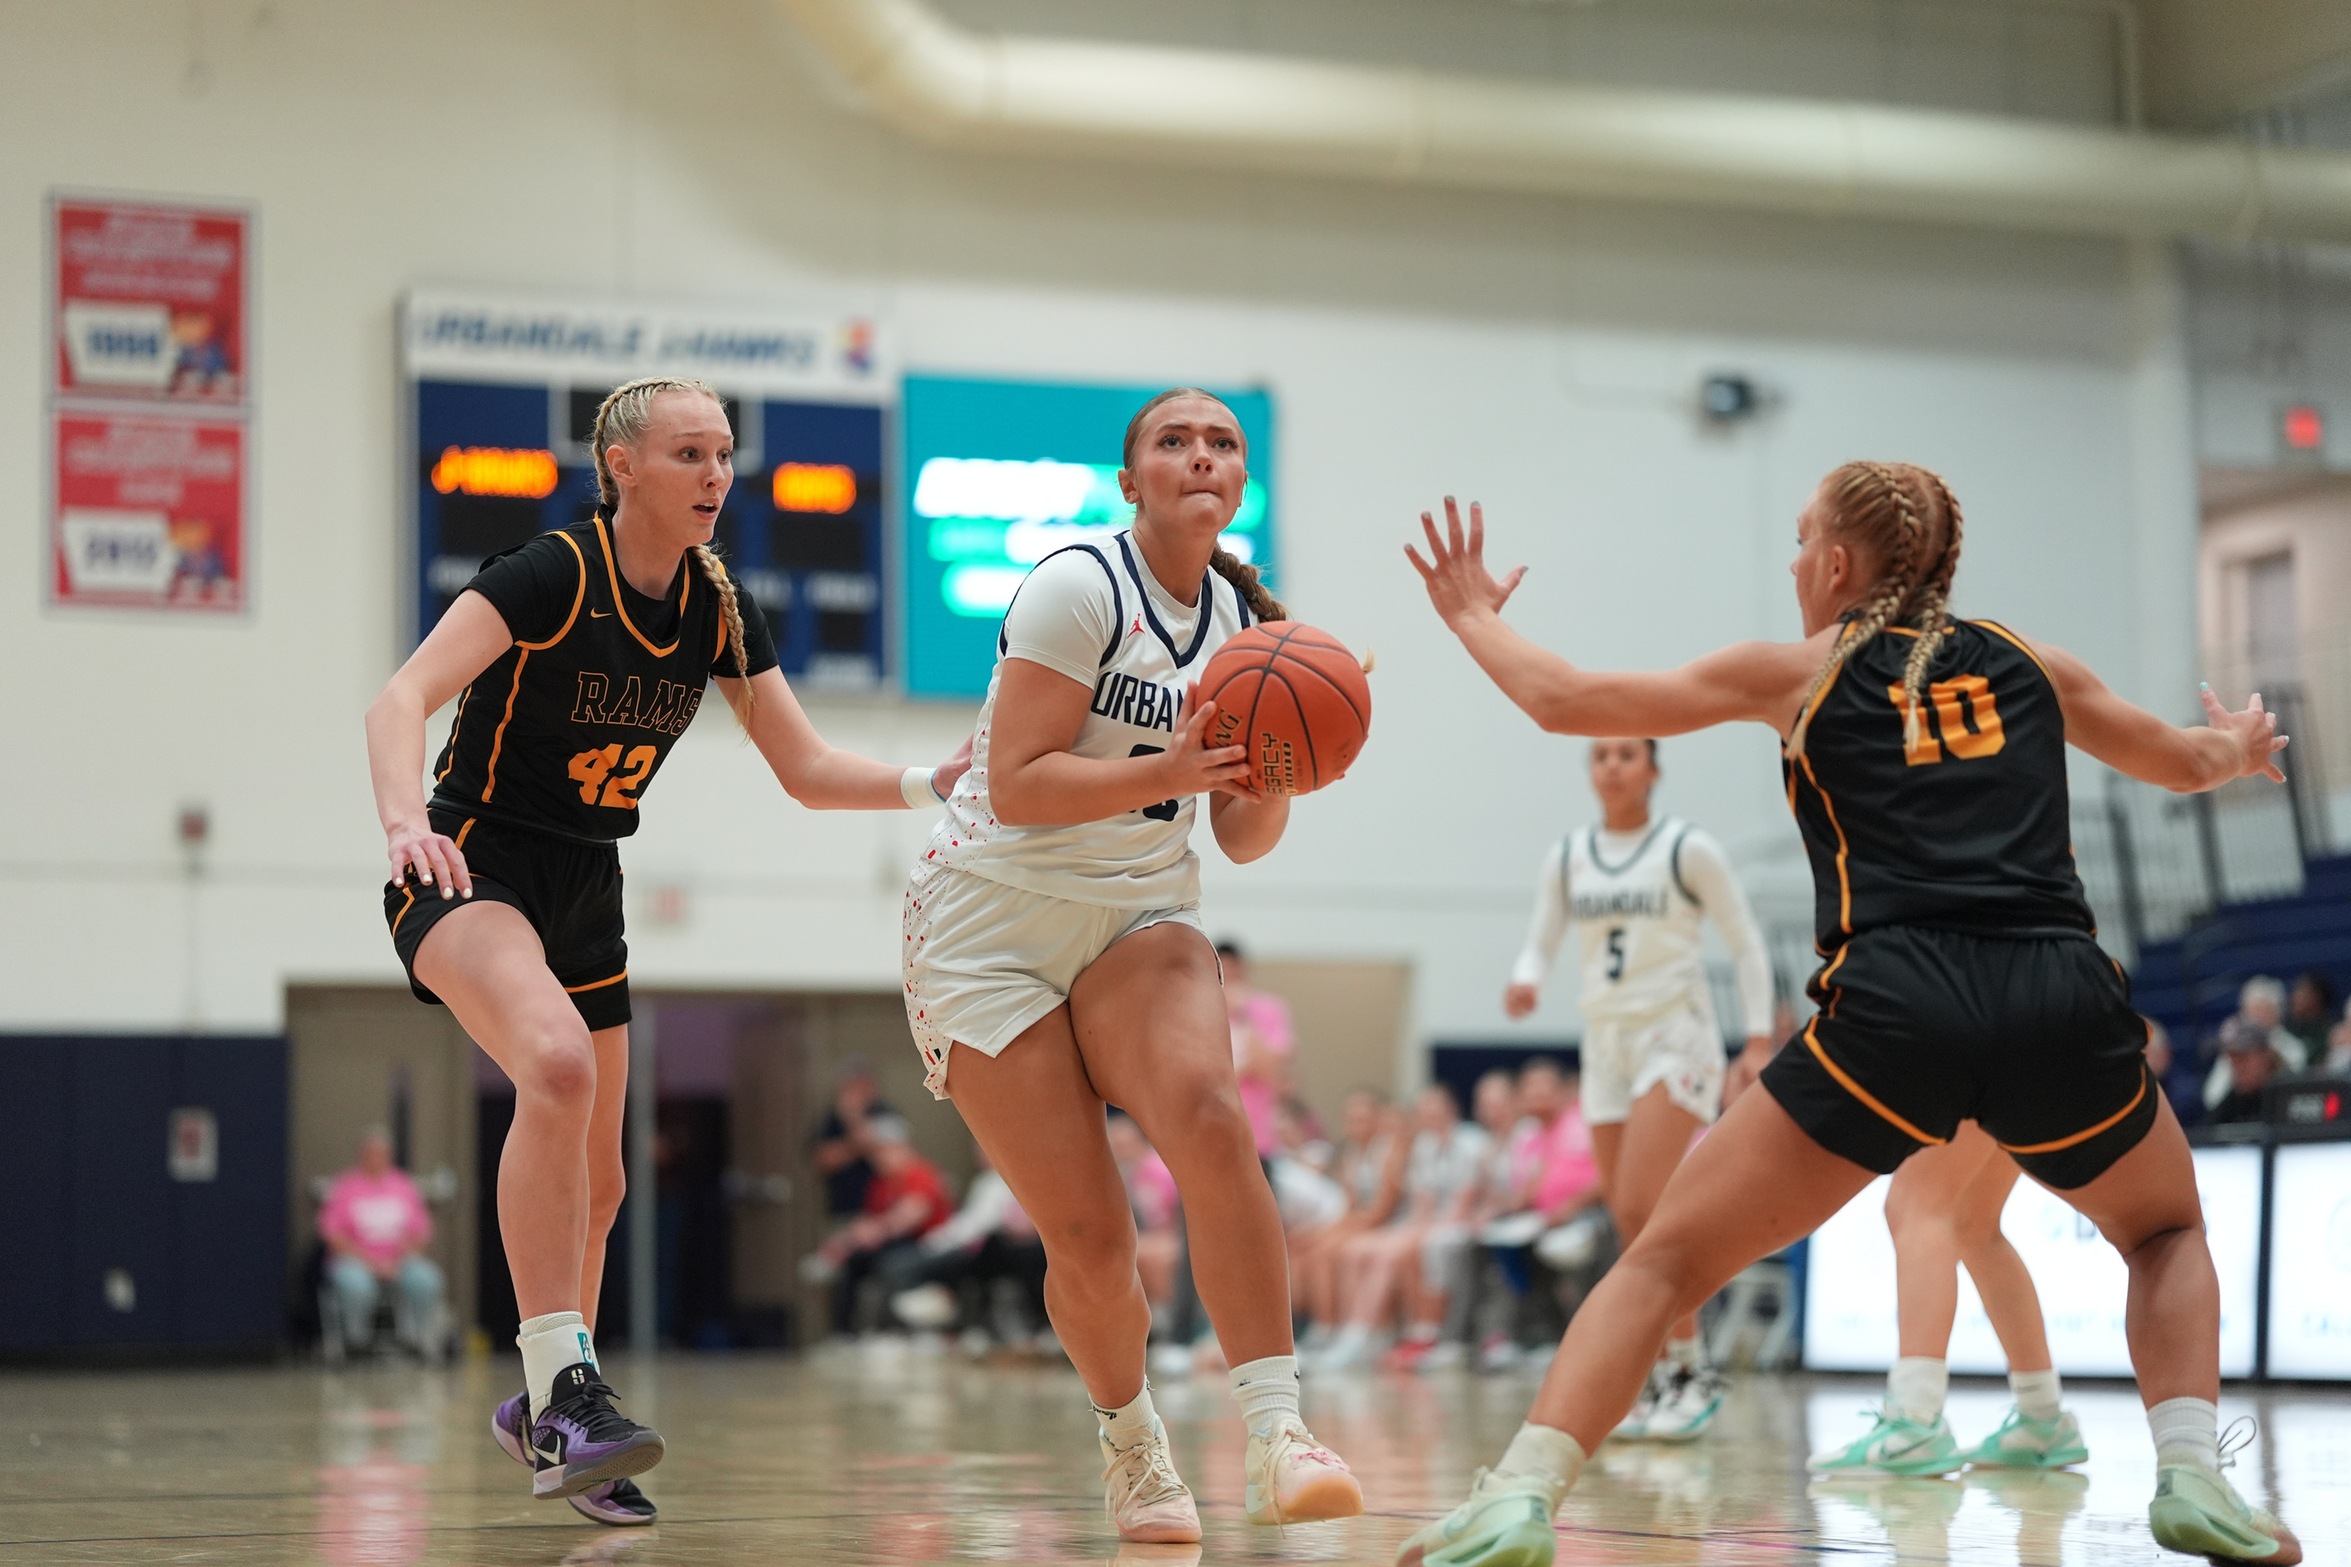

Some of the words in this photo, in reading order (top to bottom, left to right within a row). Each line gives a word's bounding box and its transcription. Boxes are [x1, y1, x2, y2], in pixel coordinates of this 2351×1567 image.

[571, 670, 704, 736] RAMS
[1887, 673, 2007, 767] 10
[567, 742, 658, 810] 42
[1262, 732, 1283, 796] EGACY
[1607, 927, 1625, 982] 5
